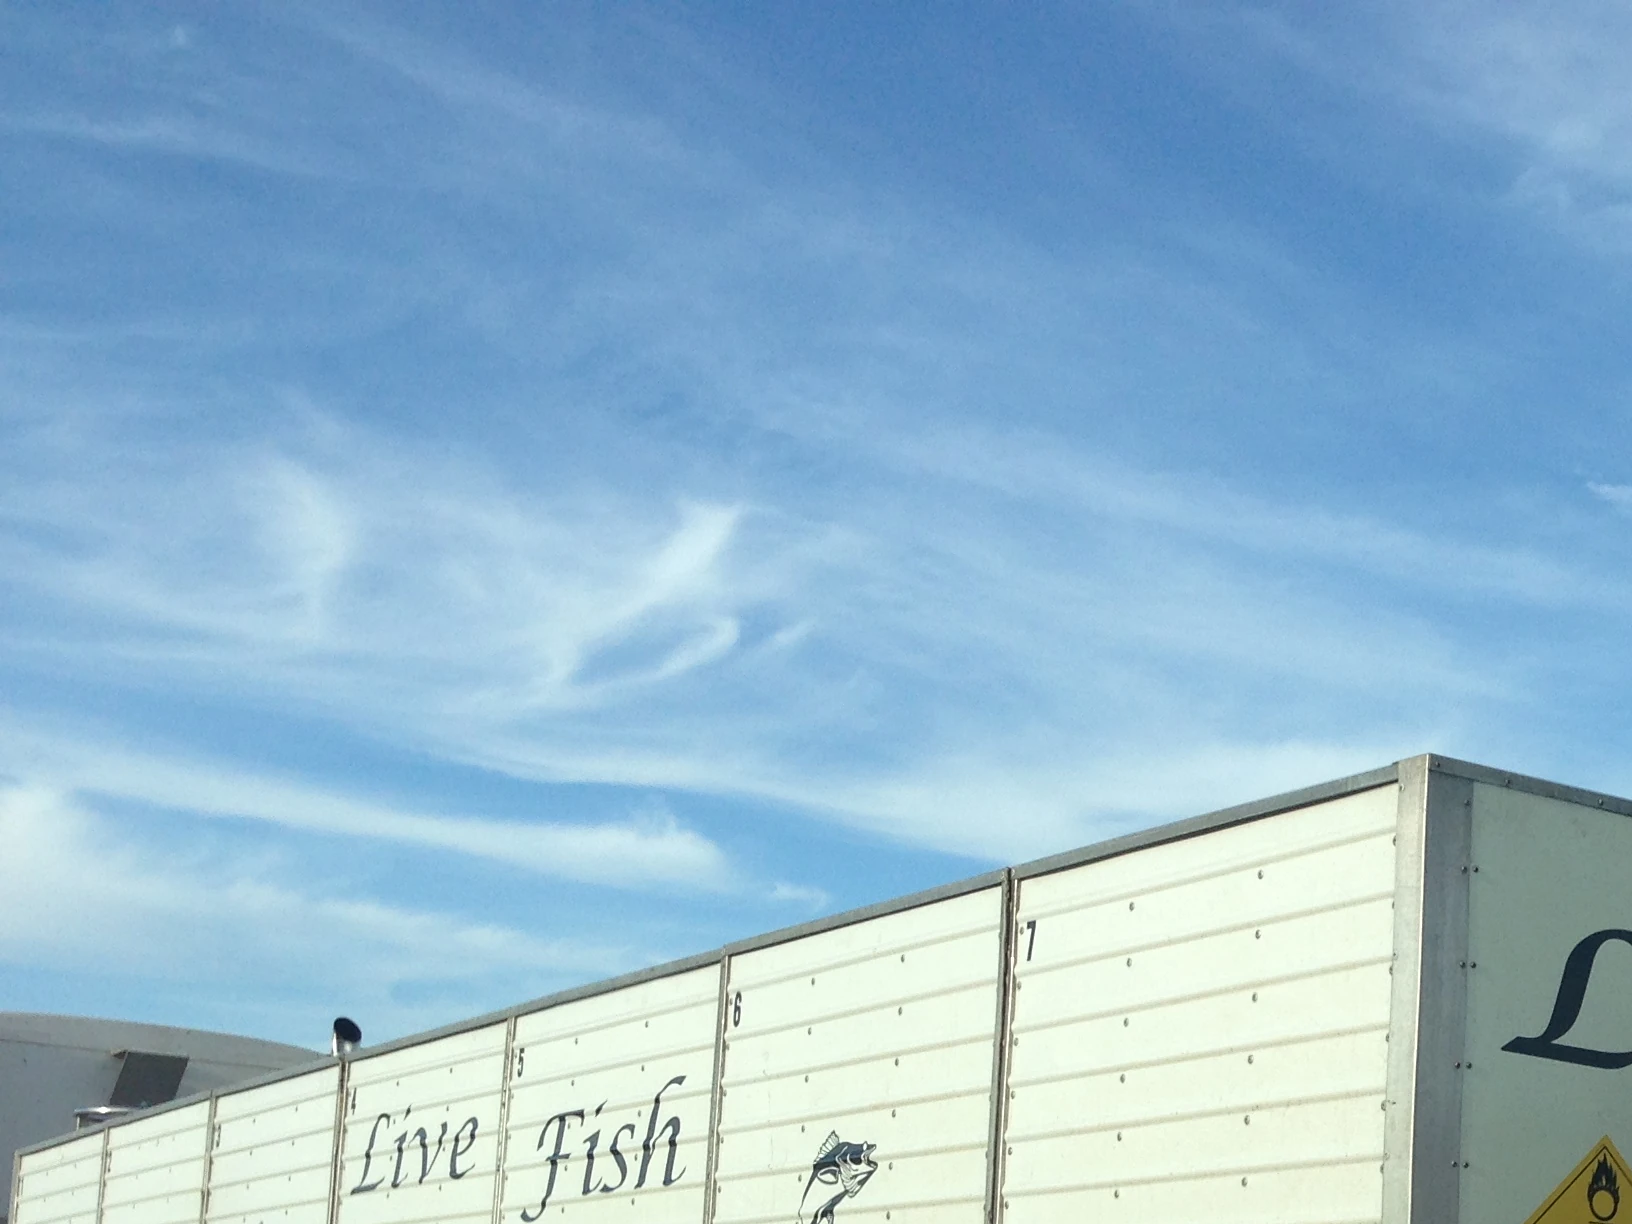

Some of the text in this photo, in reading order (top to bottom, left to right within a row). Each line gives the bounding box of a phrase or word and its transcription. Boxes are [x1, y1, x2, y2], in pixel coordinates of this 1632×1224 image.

[1026, 920, 1037, 961] 7
[732, 990, 743, 1028] 6
[517, 1047, 526, 1078] 5
[350, 1074, 688, 1223] Live Fish
